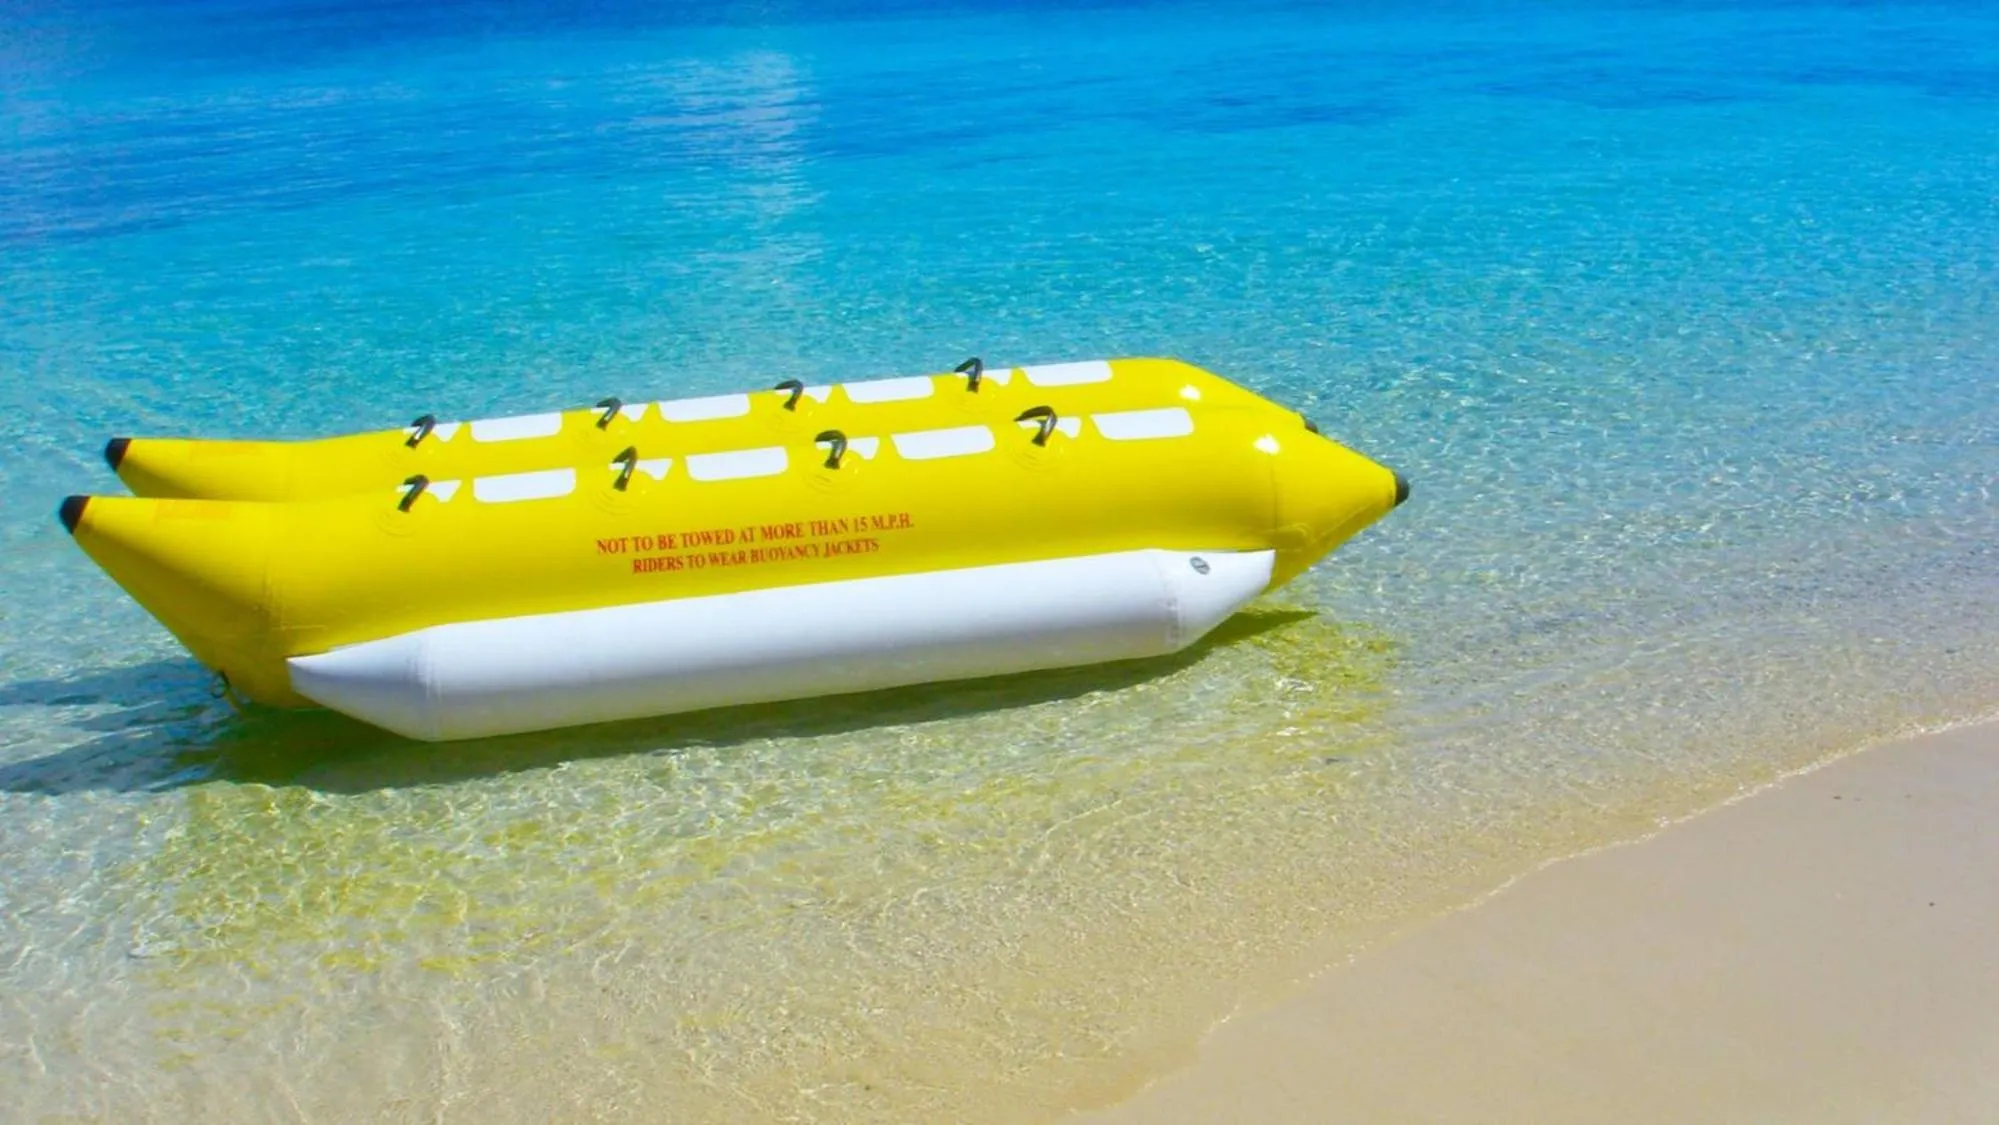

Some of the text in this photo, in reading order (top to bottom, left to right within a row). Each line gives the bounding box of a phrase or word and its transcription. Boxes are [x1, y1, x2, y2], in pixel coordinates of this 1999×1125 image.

[597, 512, 914, 554] NOT TO BE TOWED AT MORE THAN 15 M.P.H.
[633, 538, 879, 573] RIDERS TO WEAR BUOYANCY JACKETS
